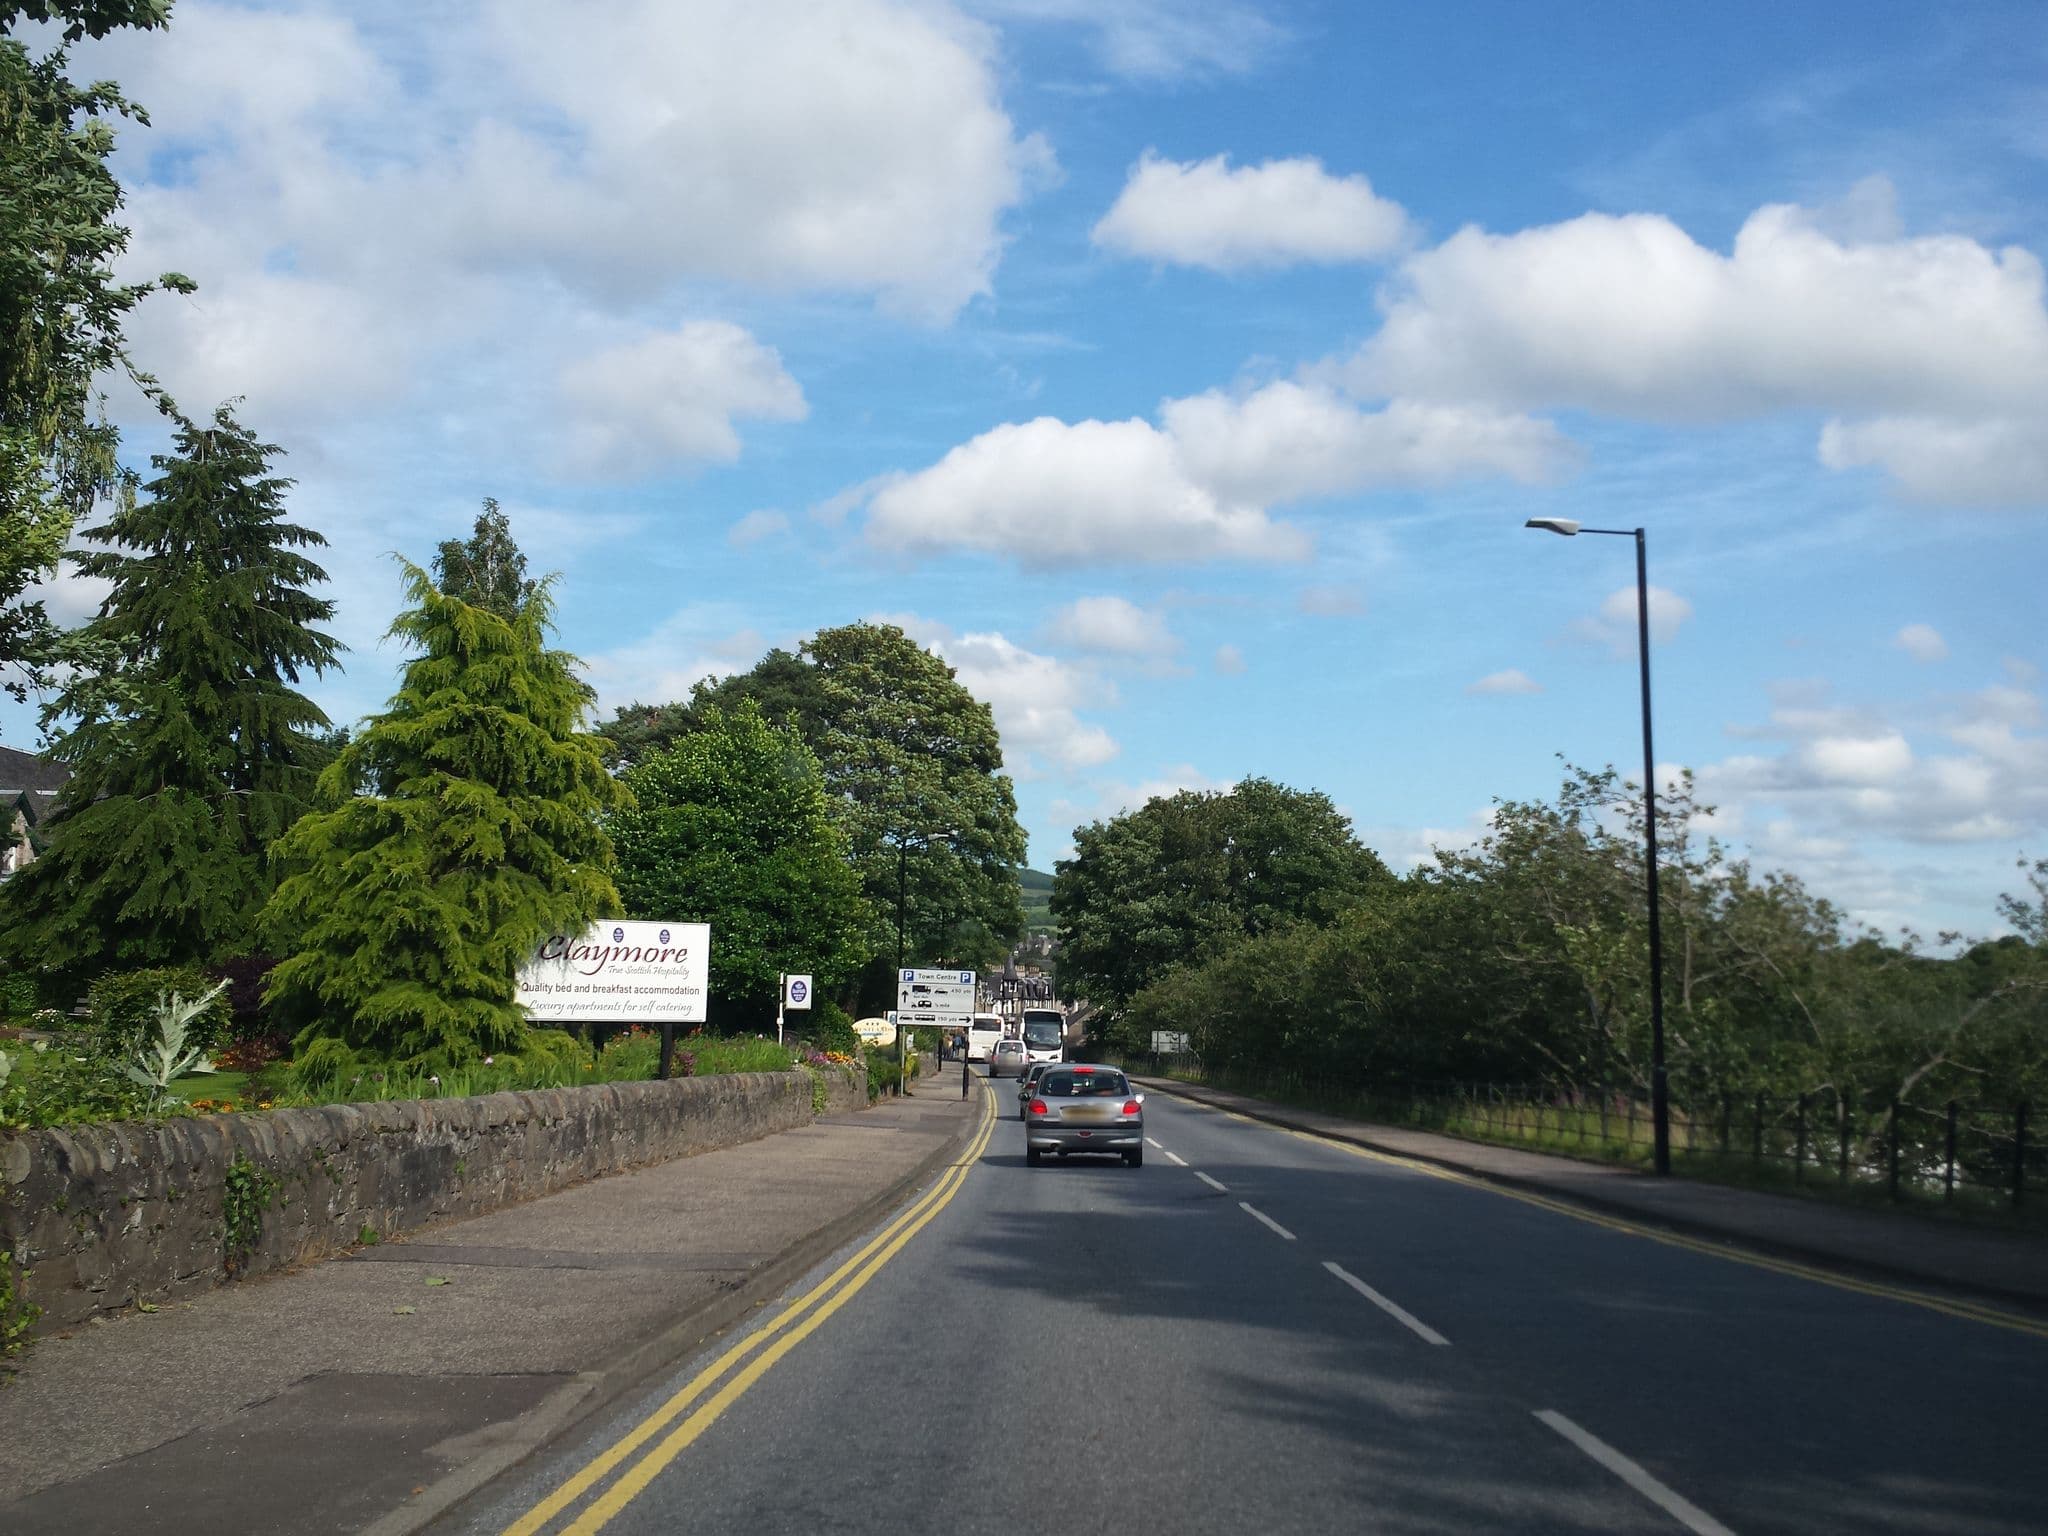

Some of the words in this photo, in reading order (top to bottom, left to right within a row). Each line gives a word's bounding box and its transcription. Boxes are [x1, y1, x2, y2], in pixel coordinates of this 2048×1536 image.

[540, 935, 688, 976] Claymore
[608, 965, 623, 974] True
[625, 965, 652, 975] Scottish
[653, 966, 690, 979] Hospitality
[521, 982, 553, 994] Quality
[555, 983, 572, 993] bed
[574, 983, 590, 993] and
[592, 983, 632, 994] breakfast
[633, 985, 700, 995] accommodation
[528, 999, 565, 1015] Luxury
[566, 1001, 621, 1015] apartments
[621, 1000, 637, 1016] for
[638, 1001, 656, 1015] self
